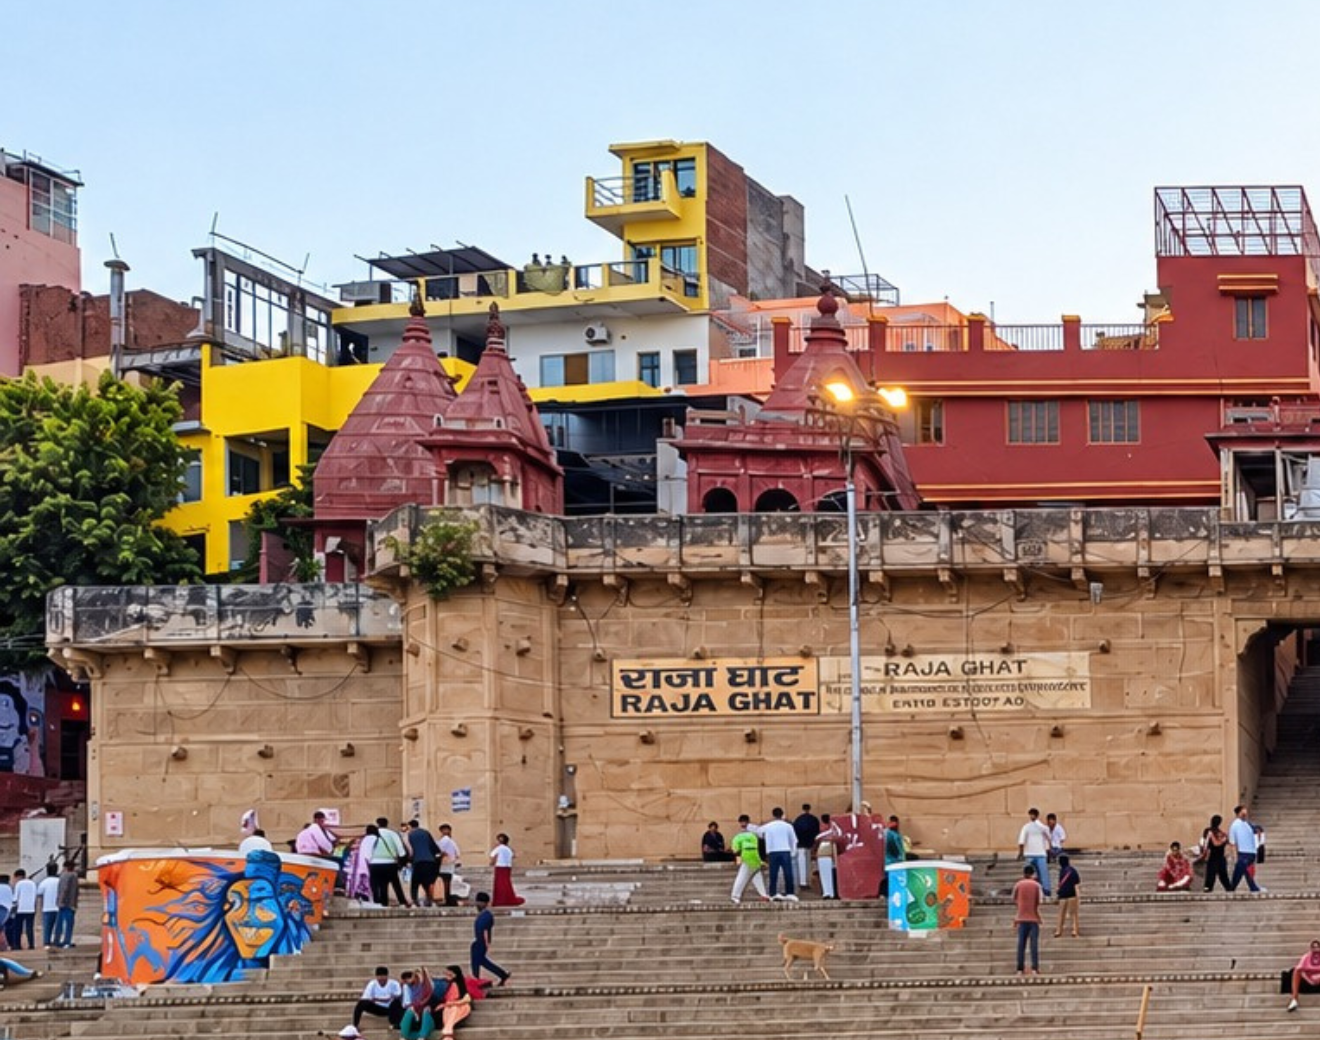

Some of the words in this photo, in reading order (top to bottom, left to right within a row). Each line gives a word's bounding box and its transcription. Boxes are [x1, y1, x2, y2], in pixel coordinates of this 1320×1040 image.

[619, 667, 717, 690] राजा
[726, 665, 804, 688] घाट
[884, 661, 951, 677] RAJA
[961, 659, 1027, 675] GHAT
[620, 693, 717, 713] RAJA
[727, 691, 816, 711] GHAT
